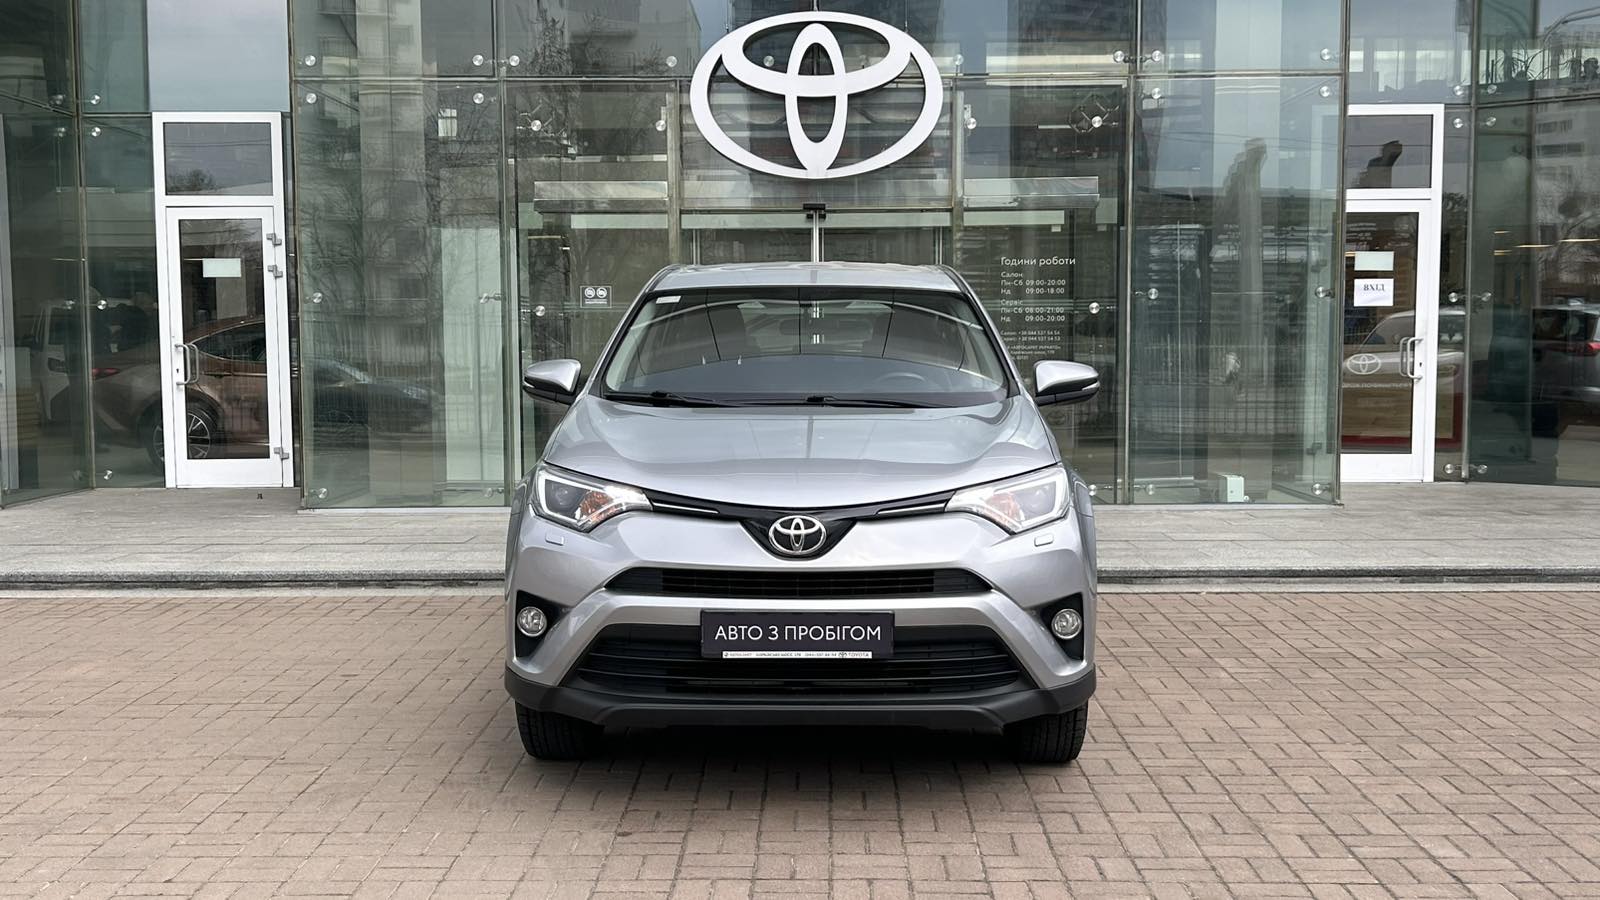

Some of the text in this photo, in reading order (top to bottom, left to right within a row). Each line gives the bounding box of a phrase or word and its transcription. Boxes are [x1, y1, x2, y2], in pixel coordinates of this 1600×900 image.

[1001, 256, 1076, 267] Години роботи
[714, 625, 882, 641] АВТО З ПРОБІГОМ
